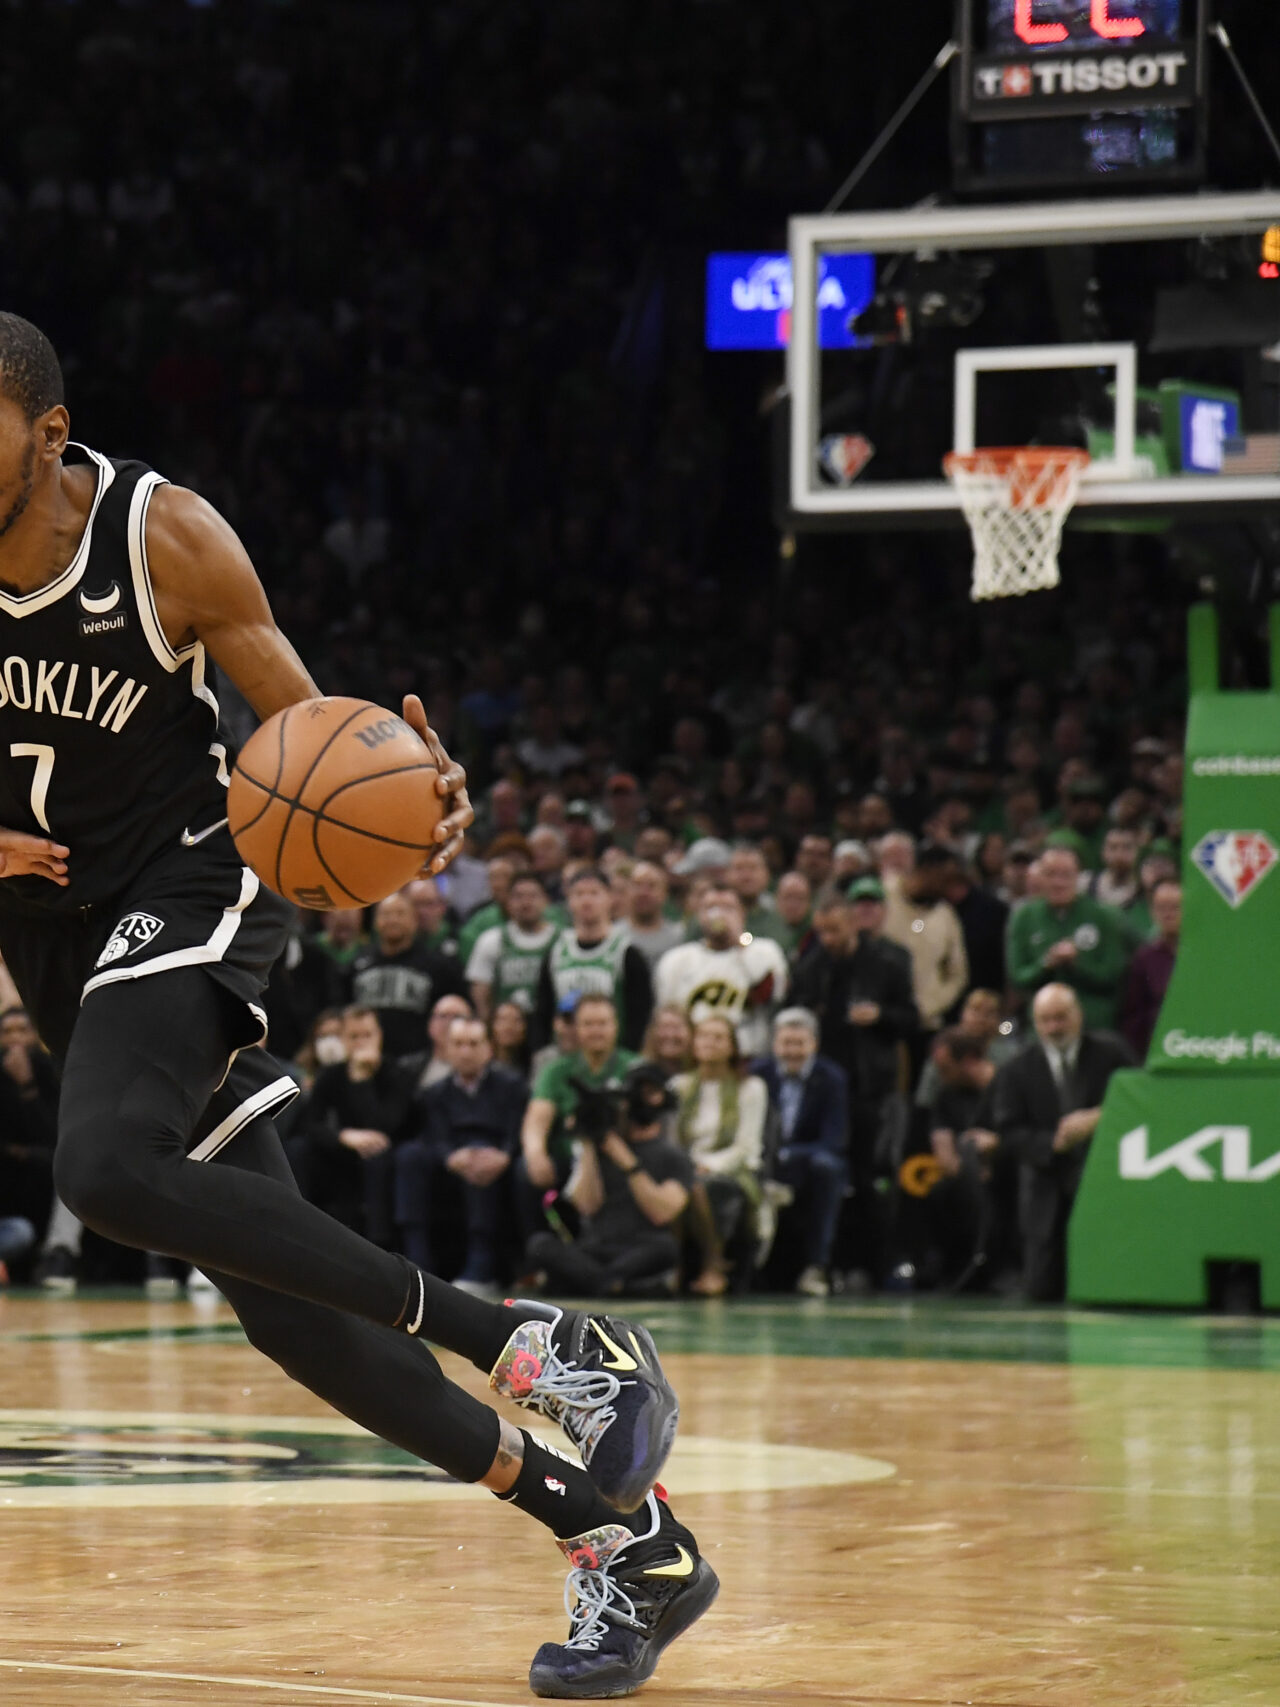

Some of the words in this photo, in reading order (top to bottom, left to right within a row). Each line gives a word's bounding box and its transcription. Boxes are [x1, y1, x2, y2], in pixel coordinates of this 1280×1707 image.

[1032, 53, 1187, 94] TISSOT
[731, 276, 846, 311] ULTA
[82, 616, 125, 634] Webull
[10, 742, 56, 834] 7
[108, 915, 157, 940] ETS
[1163, 1028, 1247, 1064] Google
